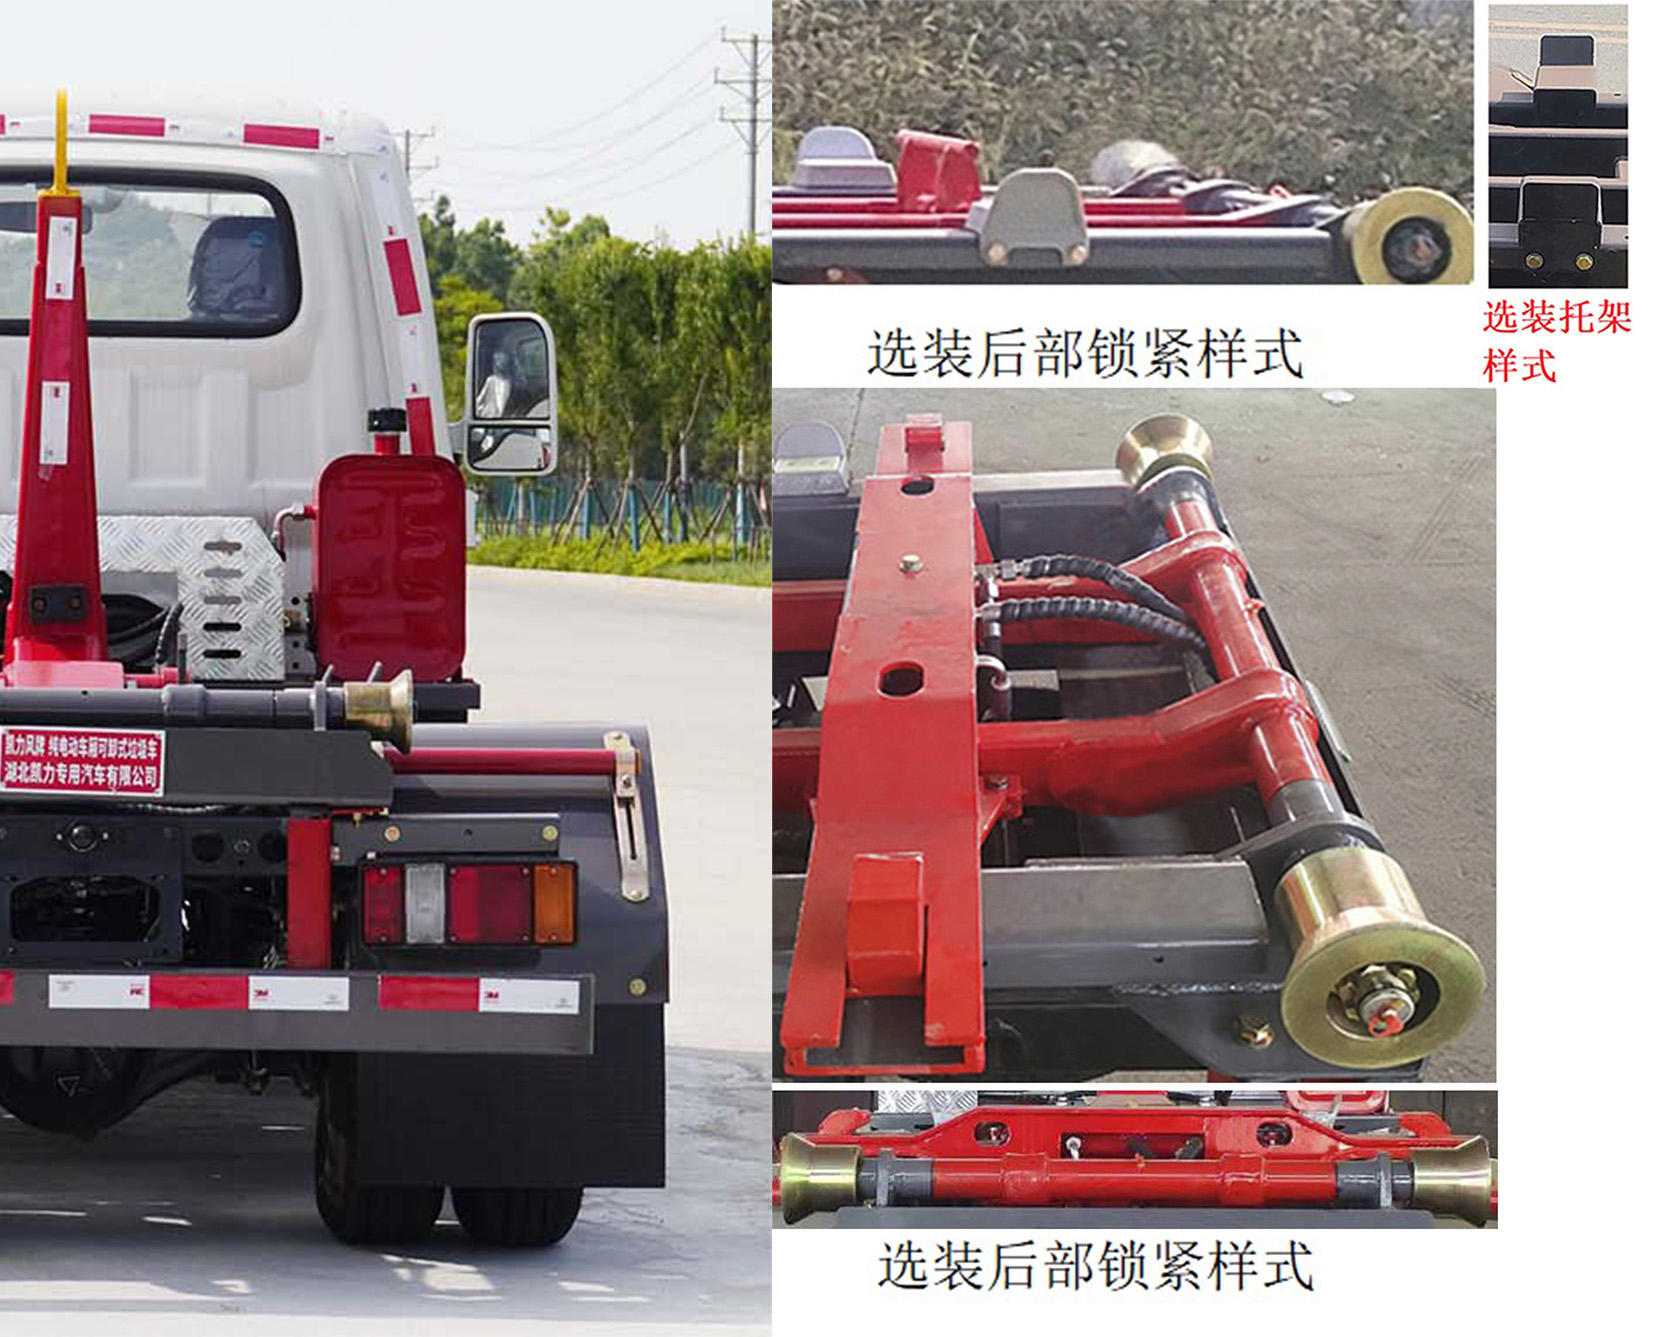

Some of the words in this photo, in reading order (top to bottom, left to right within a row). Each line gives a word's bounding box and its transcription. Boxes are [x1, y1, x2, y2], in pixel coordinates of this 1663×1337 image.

[5, 734, 45, 756] 凯力风牌
[48, 736, 158, 760] 纯电动车厢可卸式垃圾车
[4, 761, 158, 787] 湖北凯力专用汽车有限公司
